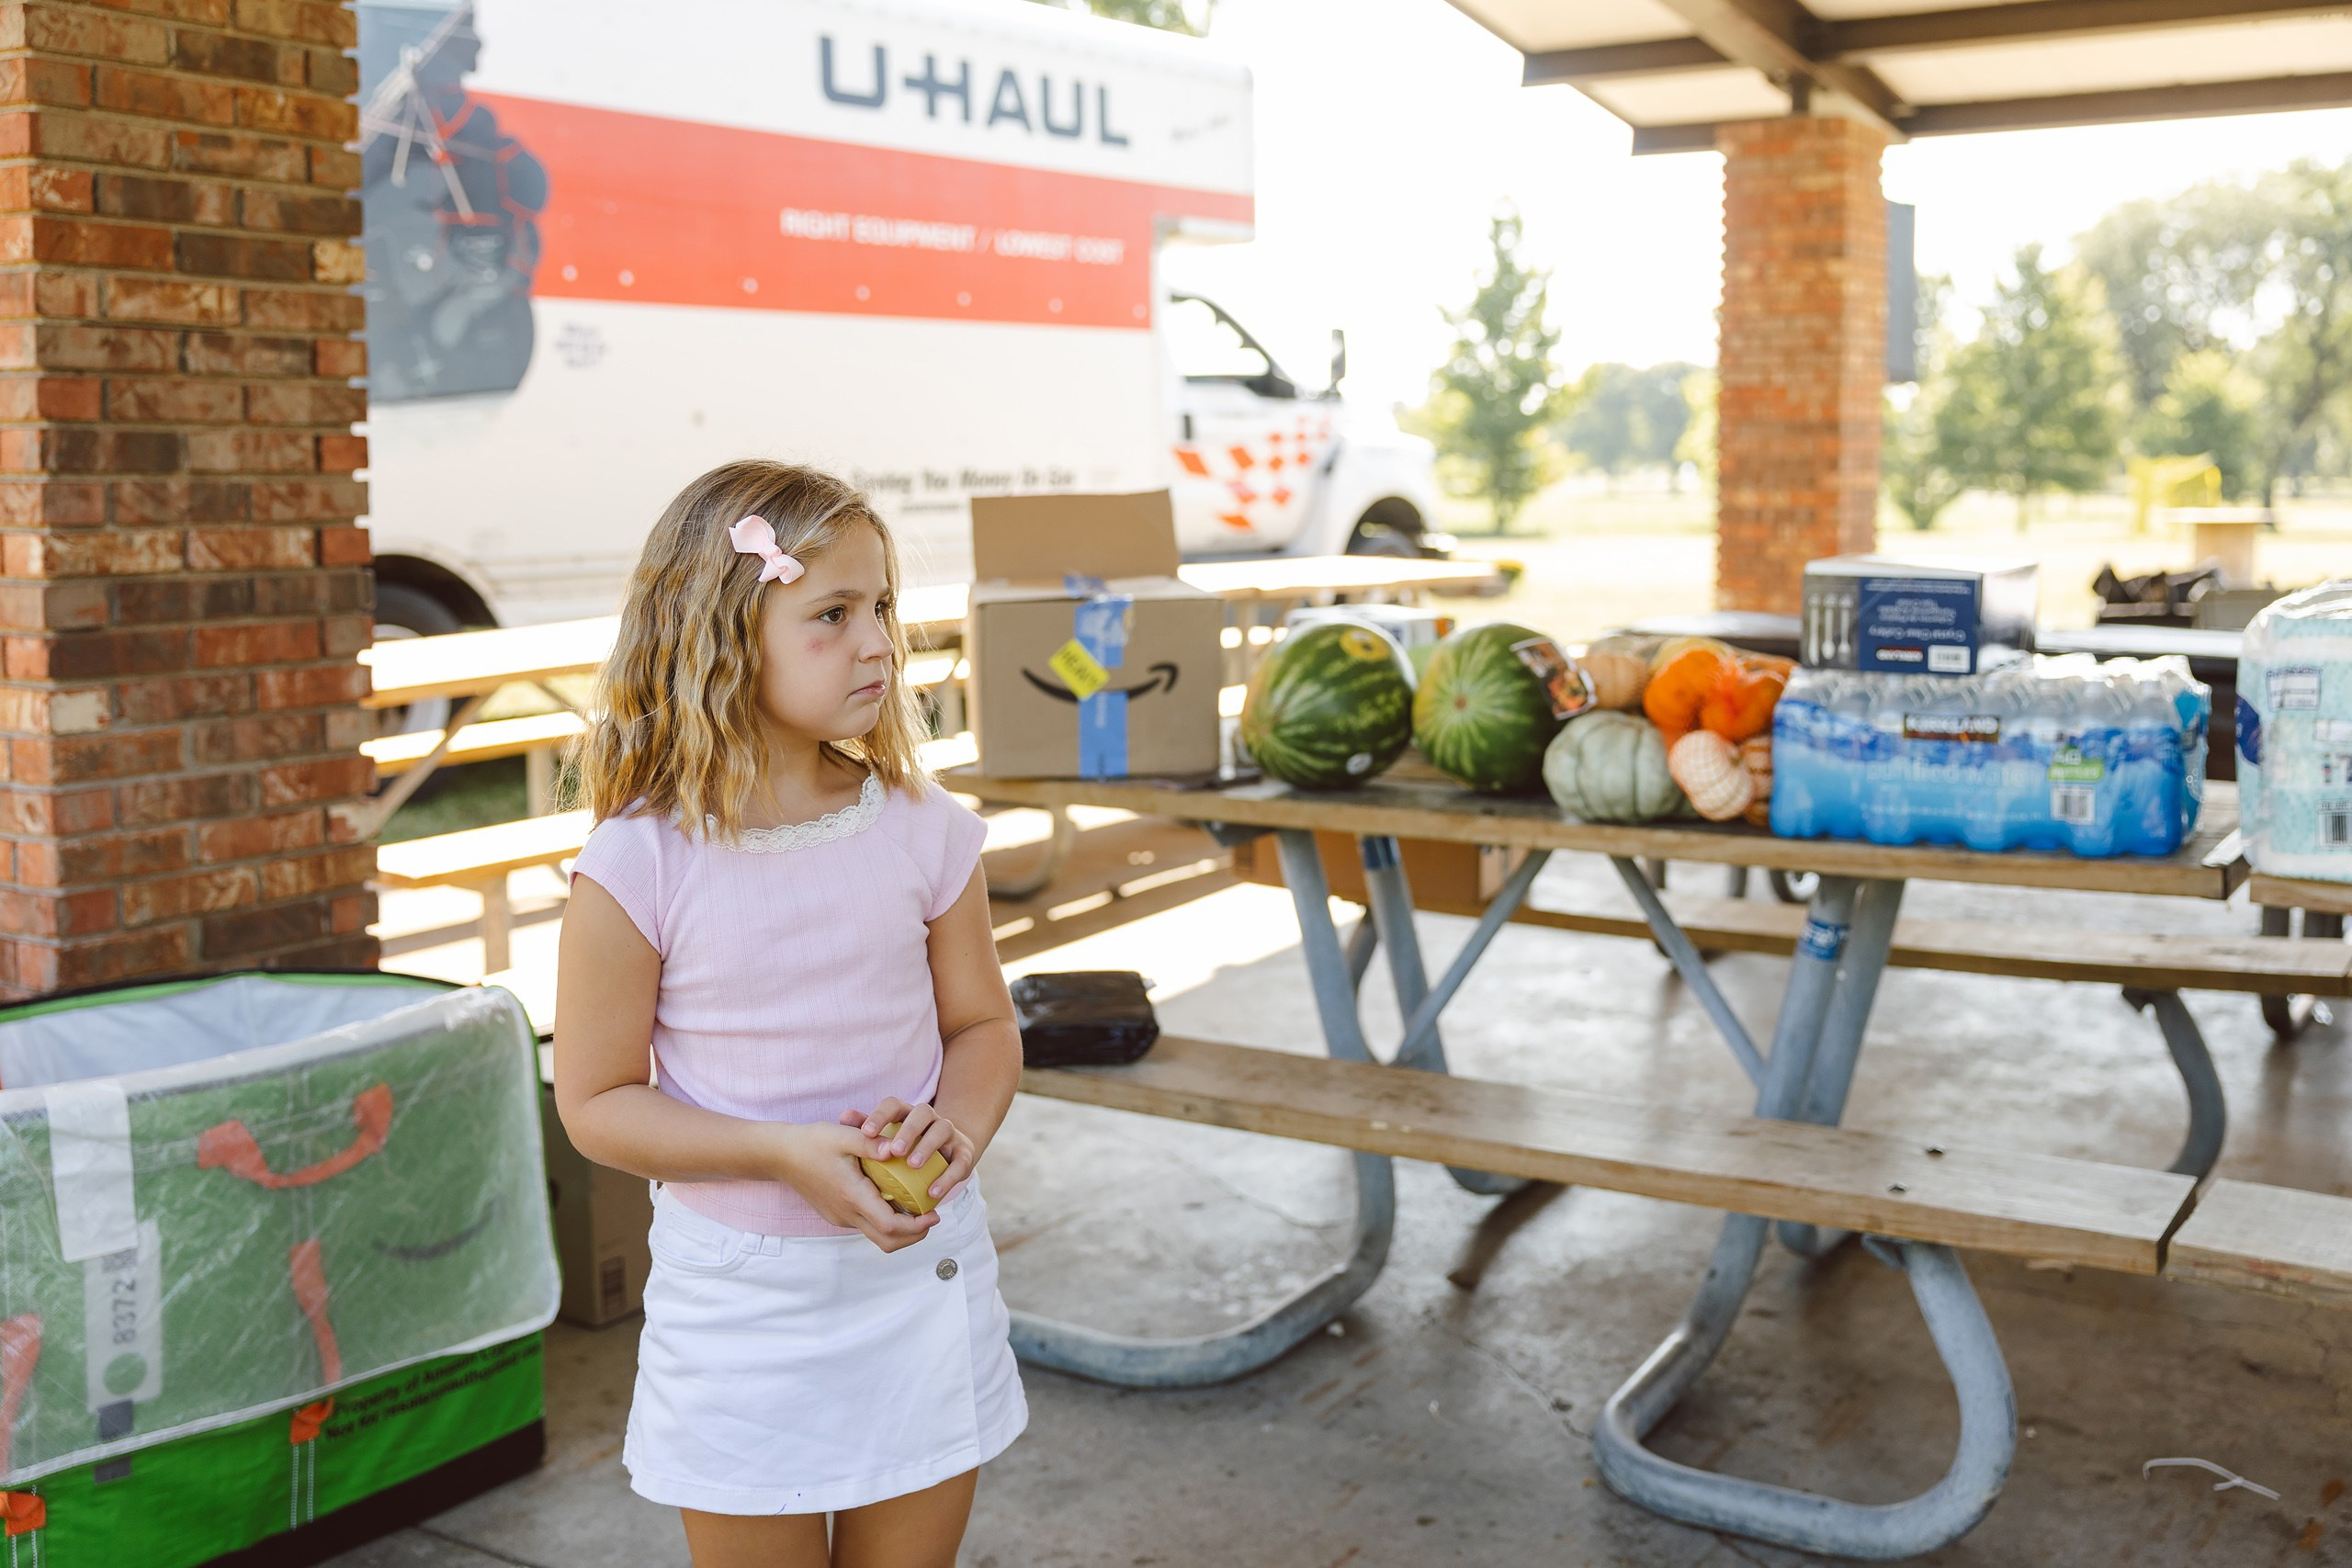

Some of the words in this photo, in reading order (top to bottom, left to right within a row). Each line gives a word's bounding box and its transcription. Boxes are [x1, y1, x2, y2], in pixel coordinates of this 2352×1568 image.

[781, 208, 850, 242] RIGHT
[853, 214, 976, 253] EQUIPMENT
[994, 229, 1072, 262] LOWEST
[1073, 236, 1125, 265] COST
[959, 468, 1011, 491] Money
[1905, 715, 1999, 734] KIRKLAND
[1865, 759, 1961, 783] purified
[1965, 764, 2041, 787] water
[2052, 766, 2100, 779] BOTTLES
[111, 1279, 137, 1345] 8372
[325, 1422, 356, 1440] Not
[358, 1412, 380, 1429] for
